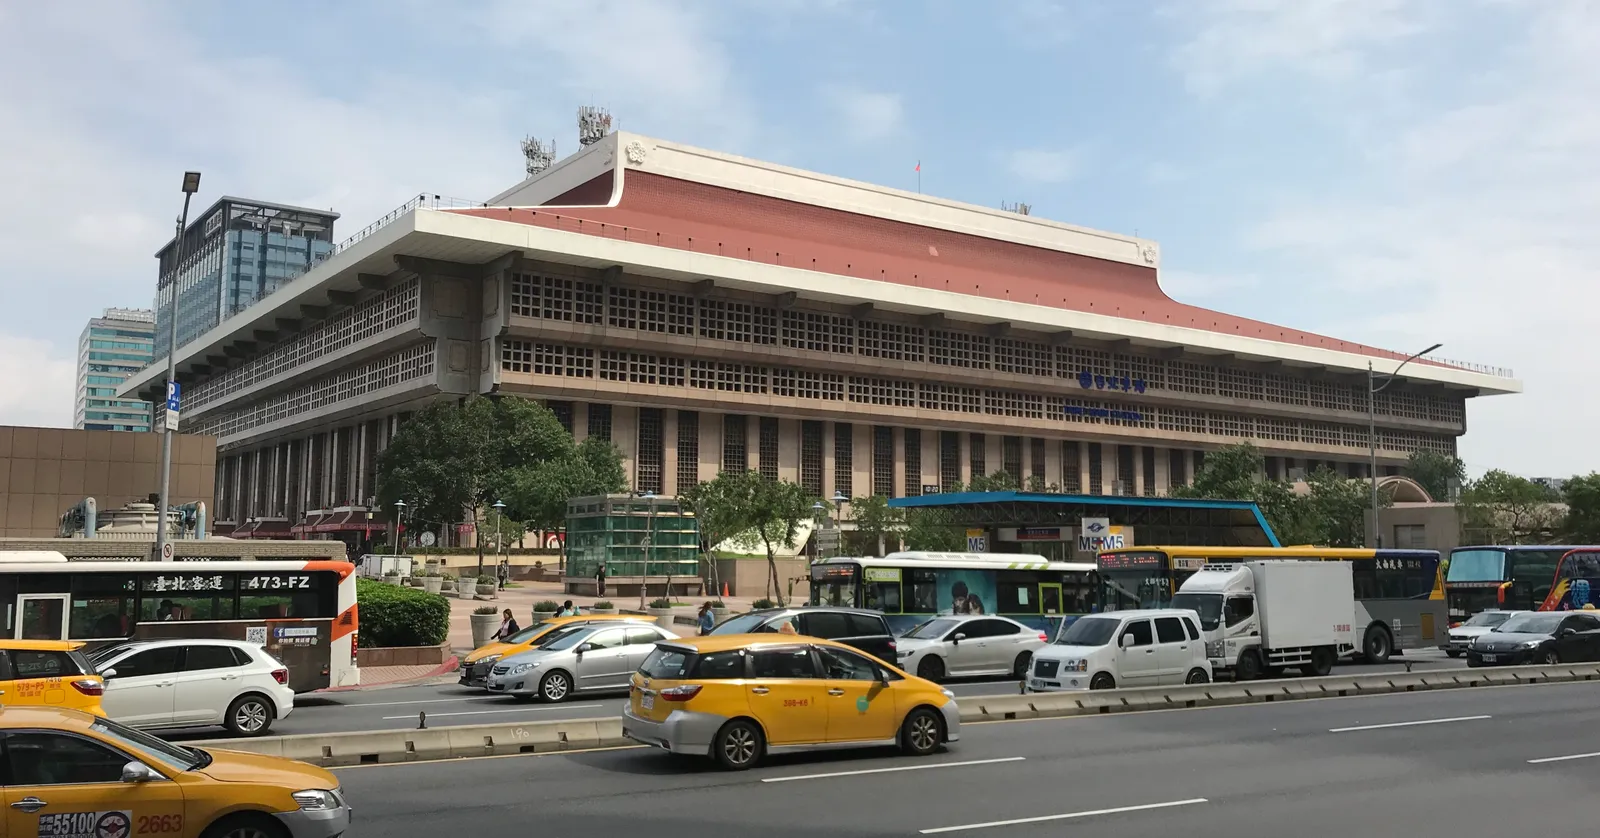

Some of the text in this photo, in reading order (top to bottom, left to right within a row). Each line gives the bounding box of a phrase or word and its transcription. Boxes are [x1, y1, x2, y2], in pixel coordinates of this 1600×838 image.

[168, 383, 175, 400] P
[968, 538, 985, 551] M5
[1079, 536, 1098, 551] M5
[1103, 536, 1124, 550] M5
[153, 575, 224, 592] 臺北客運
[248, 576, 310, 589] 473-FZ
[53, 812, 95, 835] 55100
[137, 814, 183, 834] 2663
